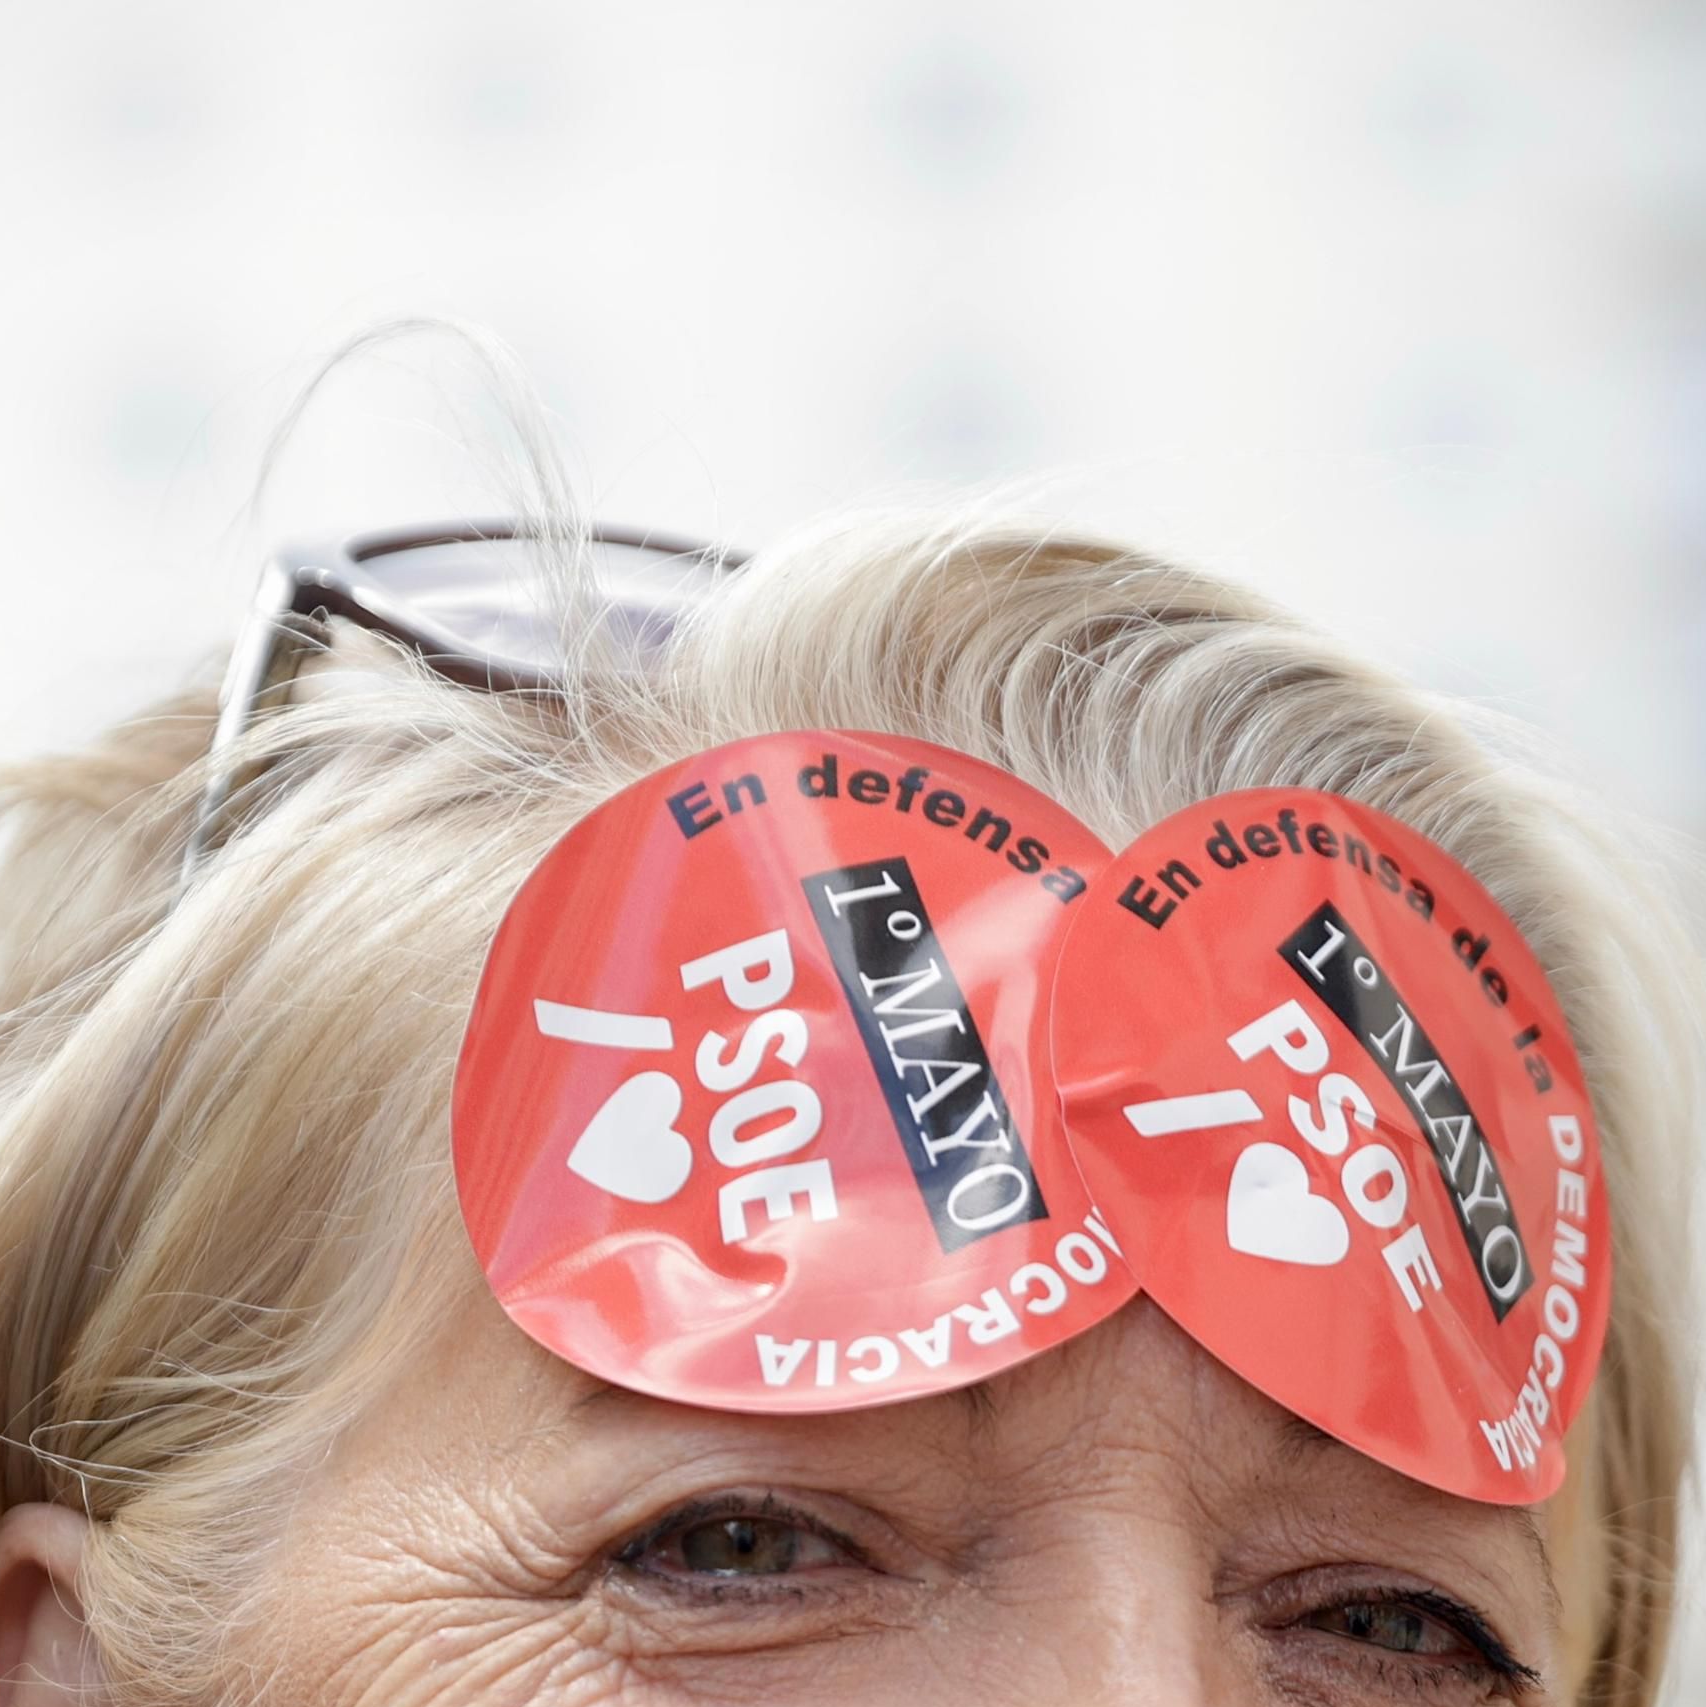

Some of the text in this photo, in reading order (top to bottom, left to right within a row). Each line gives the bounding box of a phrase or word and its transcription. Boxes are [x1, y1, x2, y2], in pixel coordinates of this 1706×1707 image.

[665, 771, 768, 840] En
[796, 754, 1088, 904] defensa
[679, 928, 840, 1245] PSOE
[858, 957, 1030, 1232] MAYO
[1116, 808, 1589, 1472] En defensa de la DEMOCRACIA
[1226, 998, 1443, 1313] PSOE
[1369, 1003, 1523, 1300] MAYO
